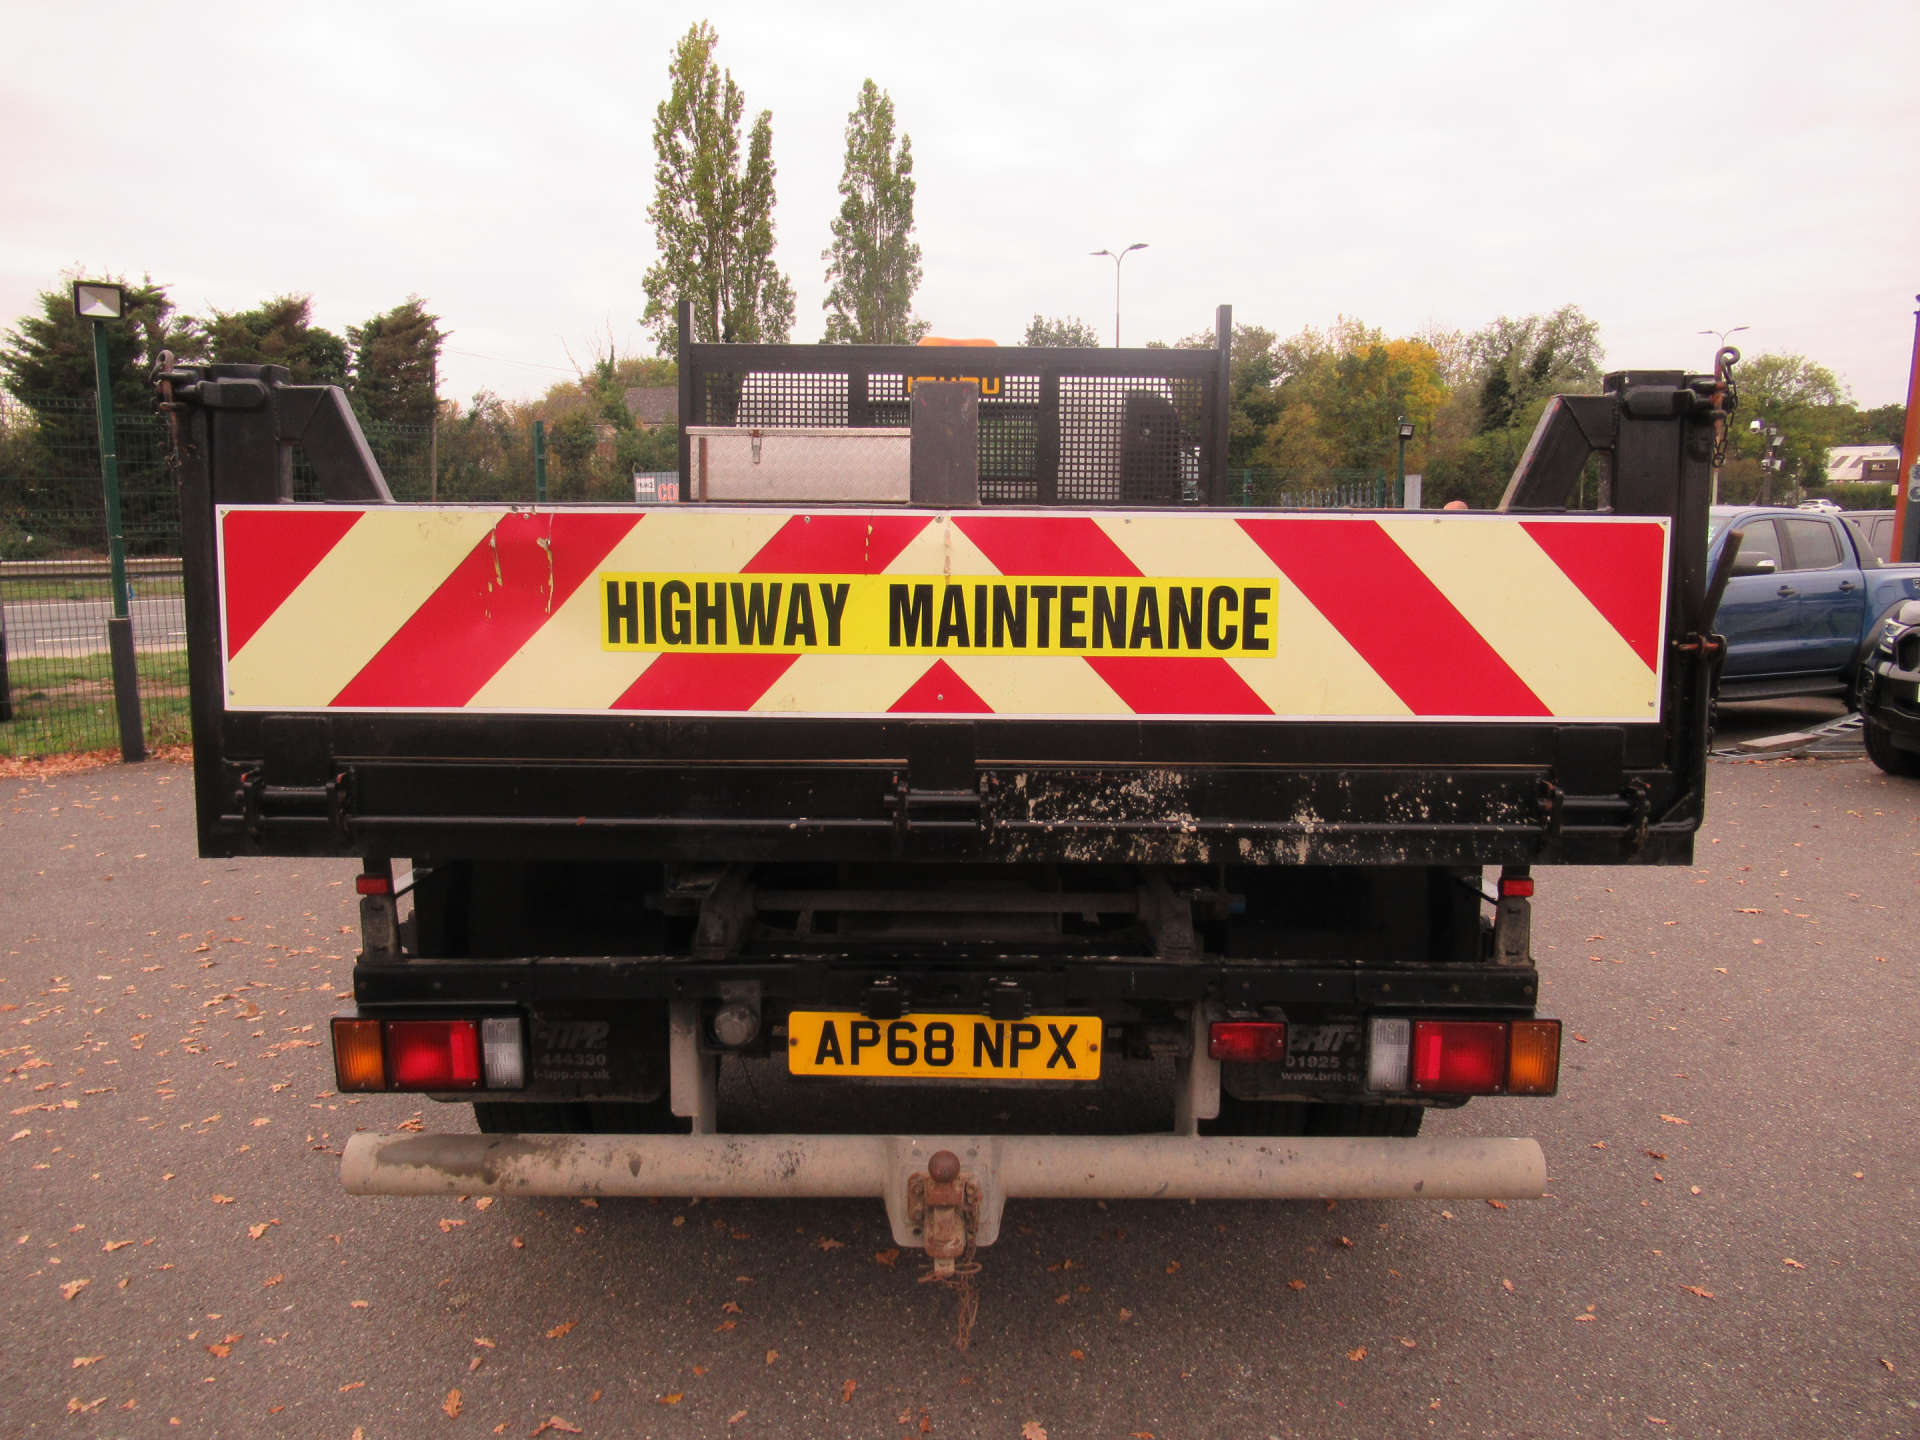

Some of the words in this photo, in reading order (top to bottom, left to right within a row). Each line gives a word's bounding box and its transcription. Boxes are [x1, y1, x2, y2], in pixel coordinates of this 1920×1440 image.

[606, 580, 851, 647] HIGHWAY
[888, 583, 1272, 651] MAINTENANCE
[814, 1020, 955, 1067] AP68
[972, 1022, 1079, 1069] NPX
